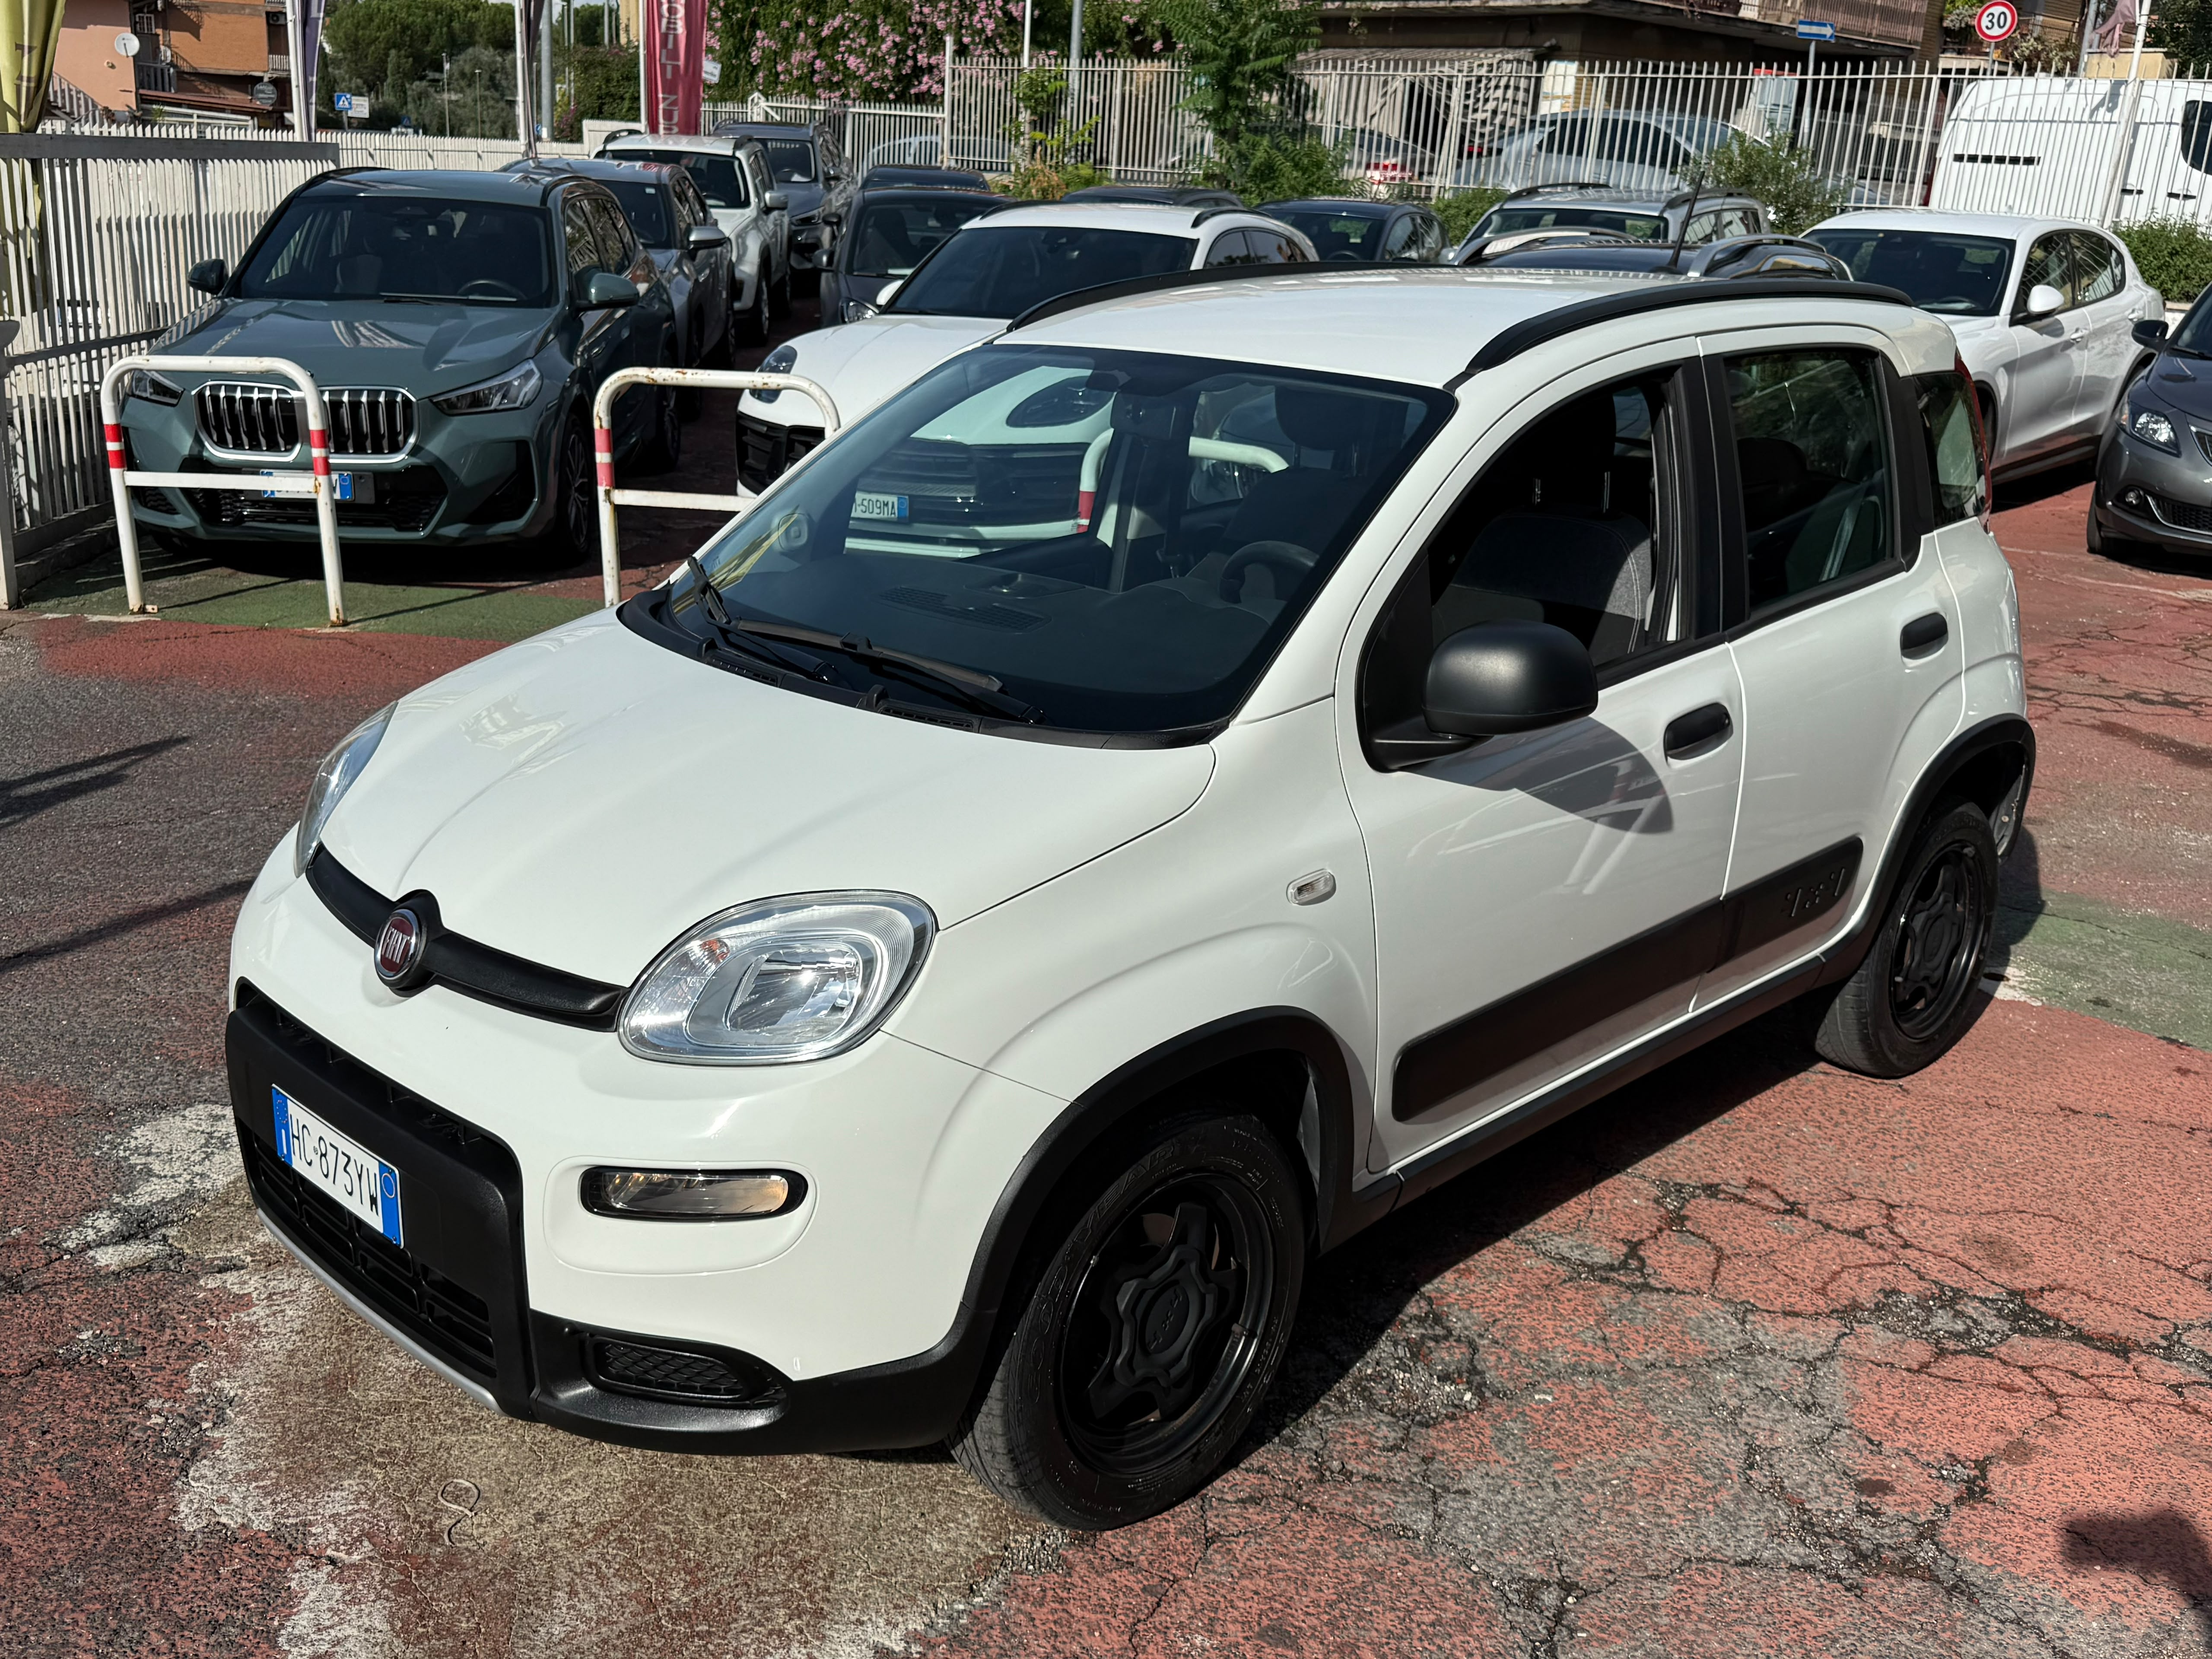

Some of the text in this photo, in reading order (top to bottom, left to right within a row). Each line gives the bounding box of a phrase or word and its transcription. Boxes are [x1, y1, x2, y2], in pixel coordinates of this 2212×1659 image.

[661, 0, 684, 79] OBILI
[1985, 11, 2007, 30] 30
[381, 926, 410, 963] FIAT
[1028, 1145, 1175, 1404] GOODYEAR
